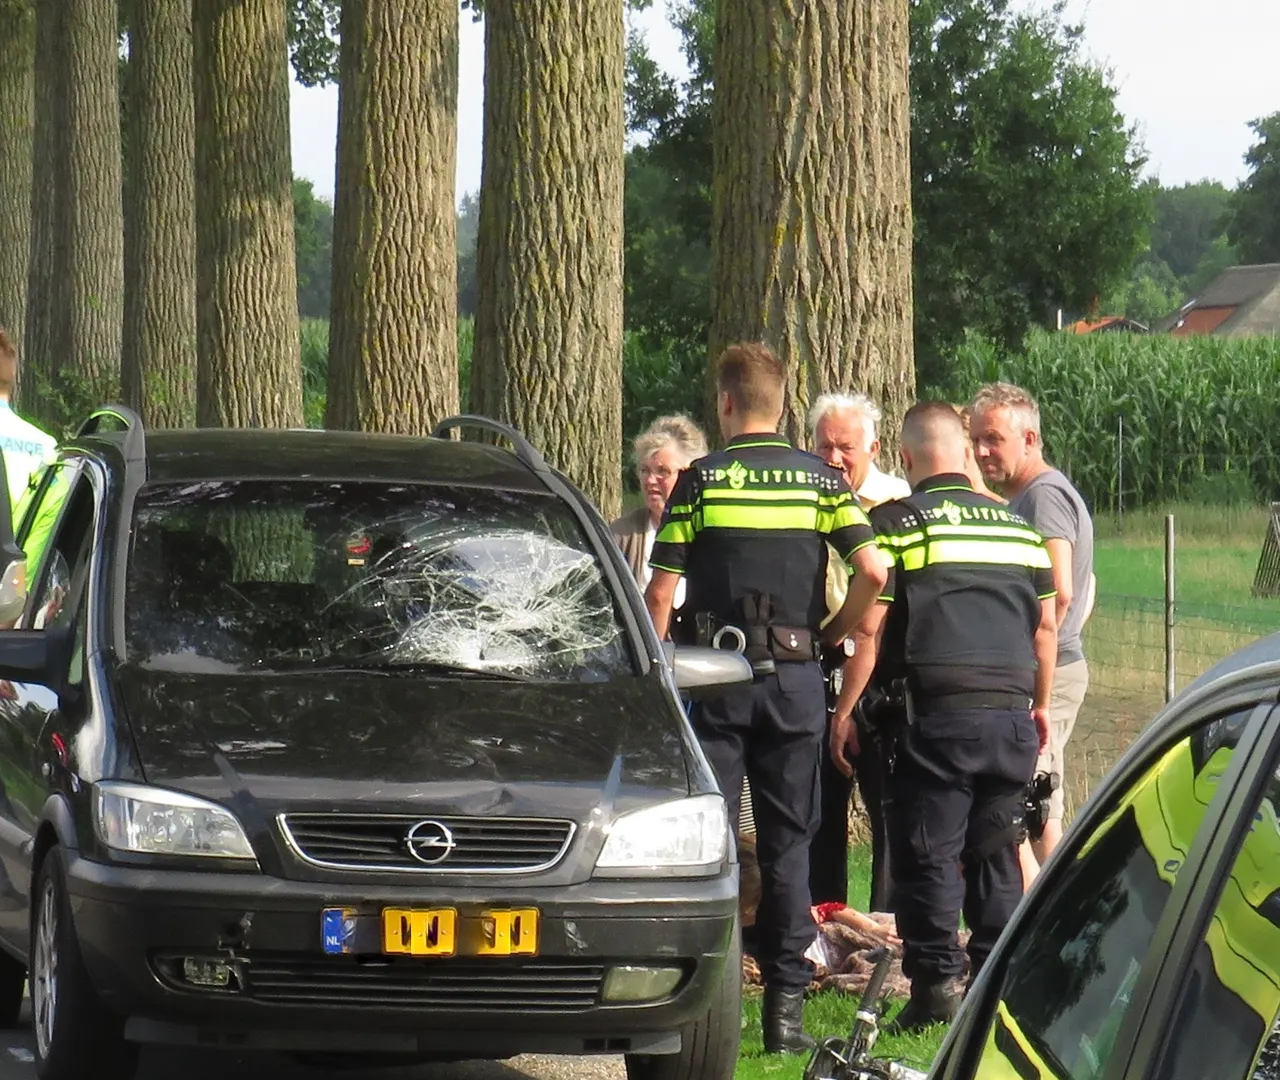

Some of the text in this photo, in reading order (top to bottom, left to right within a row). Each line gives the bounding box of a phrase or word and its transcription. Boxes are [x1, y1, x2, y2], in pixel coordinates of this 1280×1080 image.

[714, 467, 808, 489] POLITIE
[932, 505, 1010, 525] POLITIE
[326, 936, 340, 946] NL
